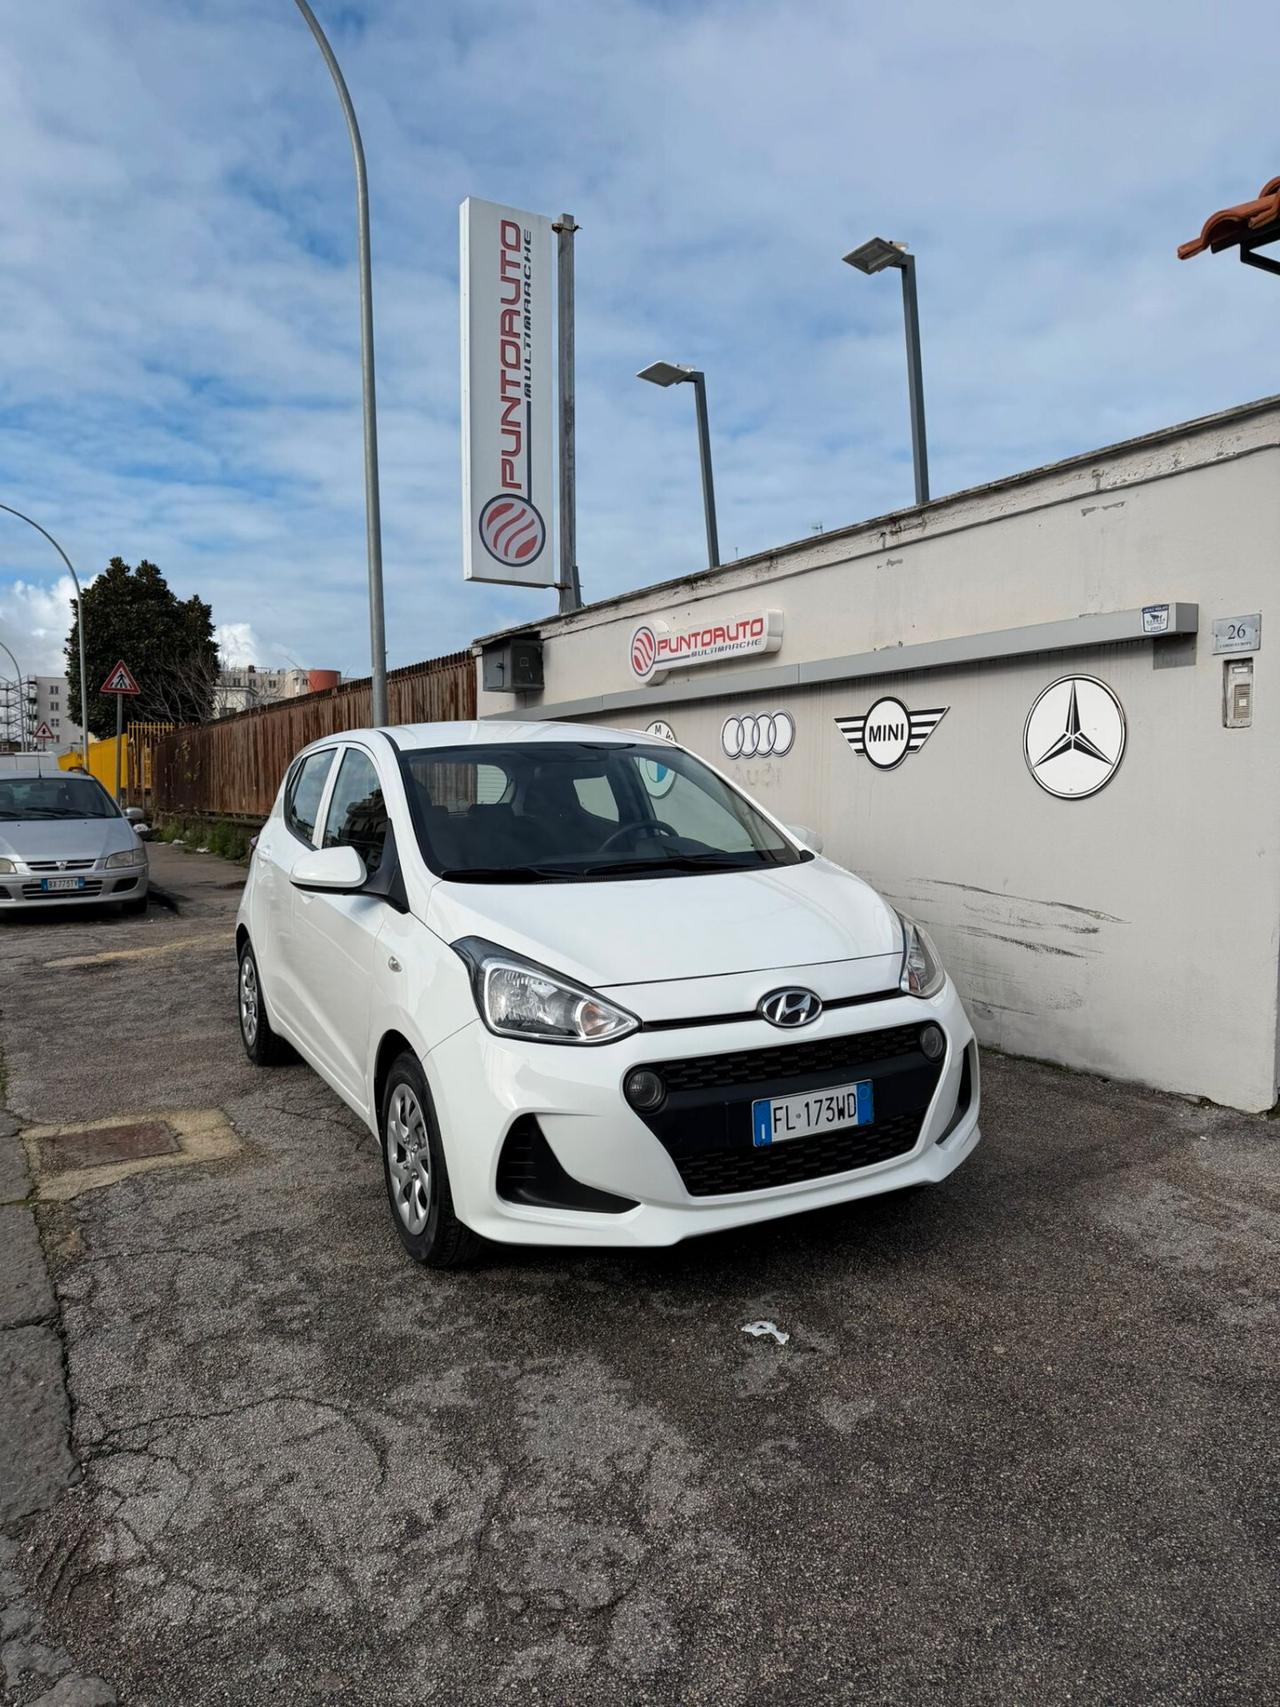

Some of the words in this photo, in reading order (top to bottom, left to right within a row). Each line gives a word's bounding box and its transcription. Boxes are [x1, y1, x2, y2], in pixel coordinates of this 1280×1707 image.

[523, 229, 533, 399] MULTIMARCHE
[500, 219, 522, 490] PUNTOAUTO
[656, 617, 764, 656] PUNTOAUTO
[690, 638, 762, 657] MULTIMARCHE
[1227, 623, 1246, 640] 26
[868, 723, 905, 743] MINI
[804, 1092, 857, 1127] 173WD
